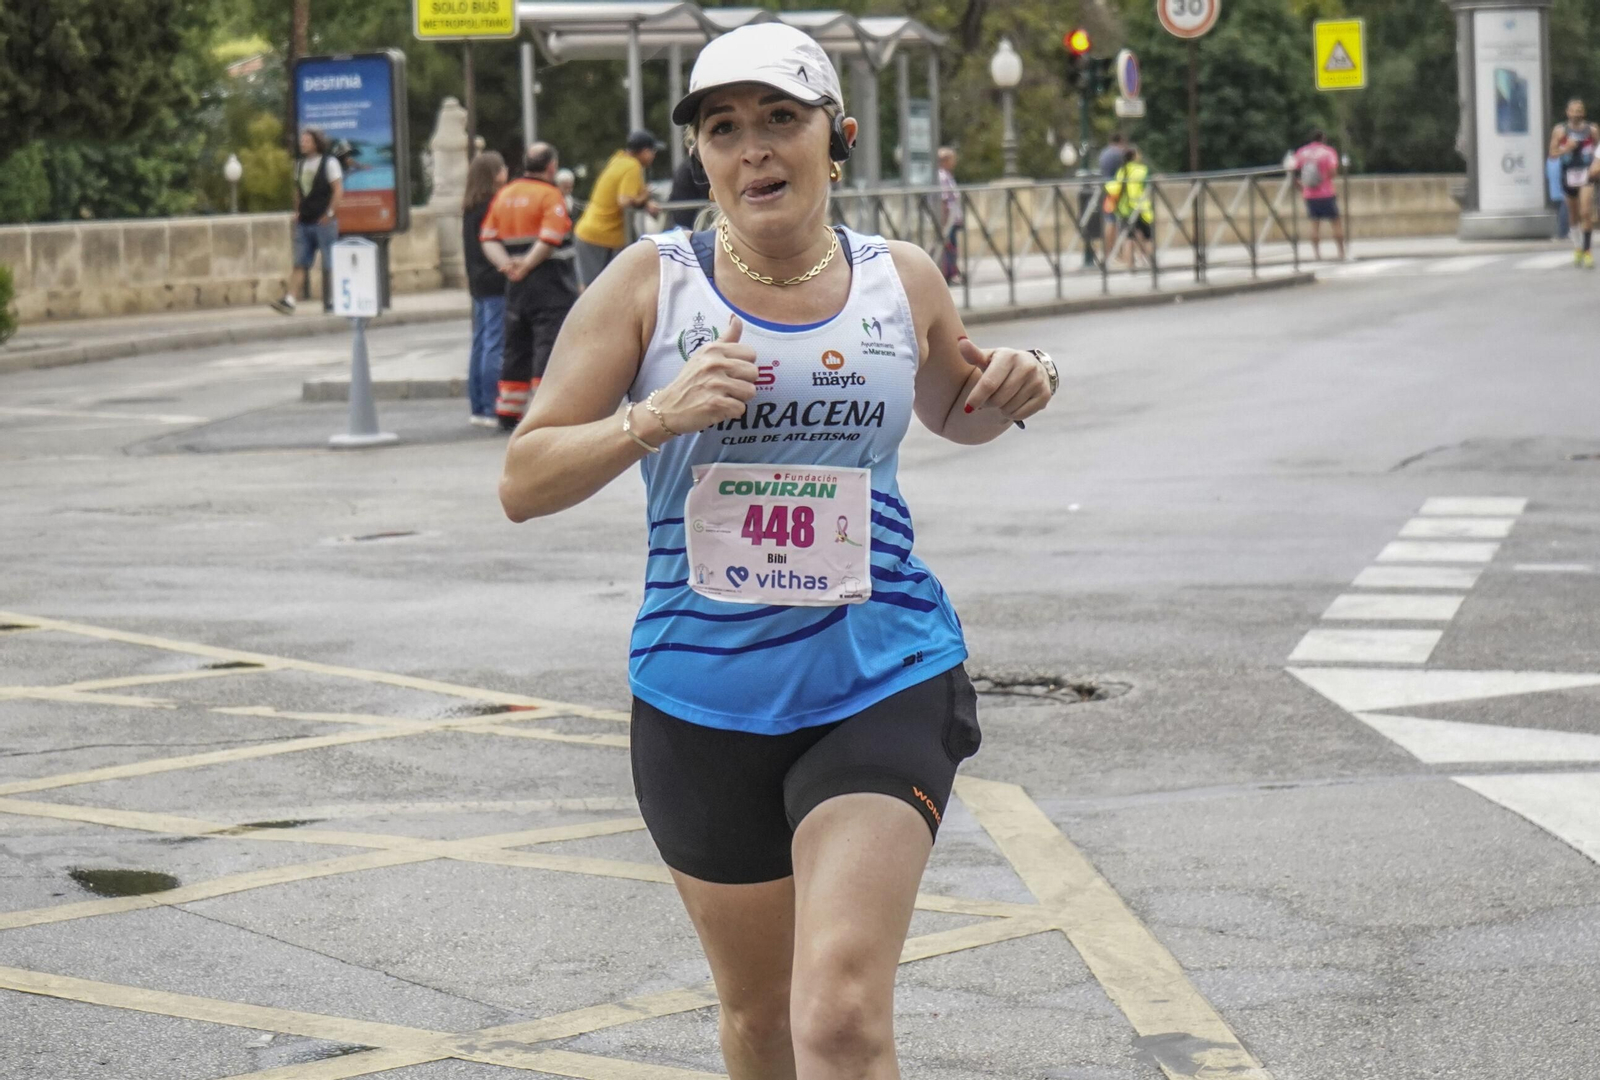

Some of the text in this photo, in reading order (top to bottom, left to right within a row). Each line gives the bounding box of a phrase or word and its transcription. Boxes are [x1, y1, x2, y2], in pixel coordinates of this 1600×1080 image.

[431, 1, 499, 14] SOLO BUS
[1172, 0, 1203, 16] 30
[342, 279, 351, 310] 5
[868, 348, 896, 357] Maracena
[812, 372, 866, 388] mayfo
[721, 432, 860, 446] CLUB DE ATLETISMO
[784, 473, 838, 483] Fundación
[718, 480, 837, 499] COVIRAN
[741, 504, 815, 548] 448
[767, 553, 787, 564] Bibi
[755, 570, 828, 590] vithas
